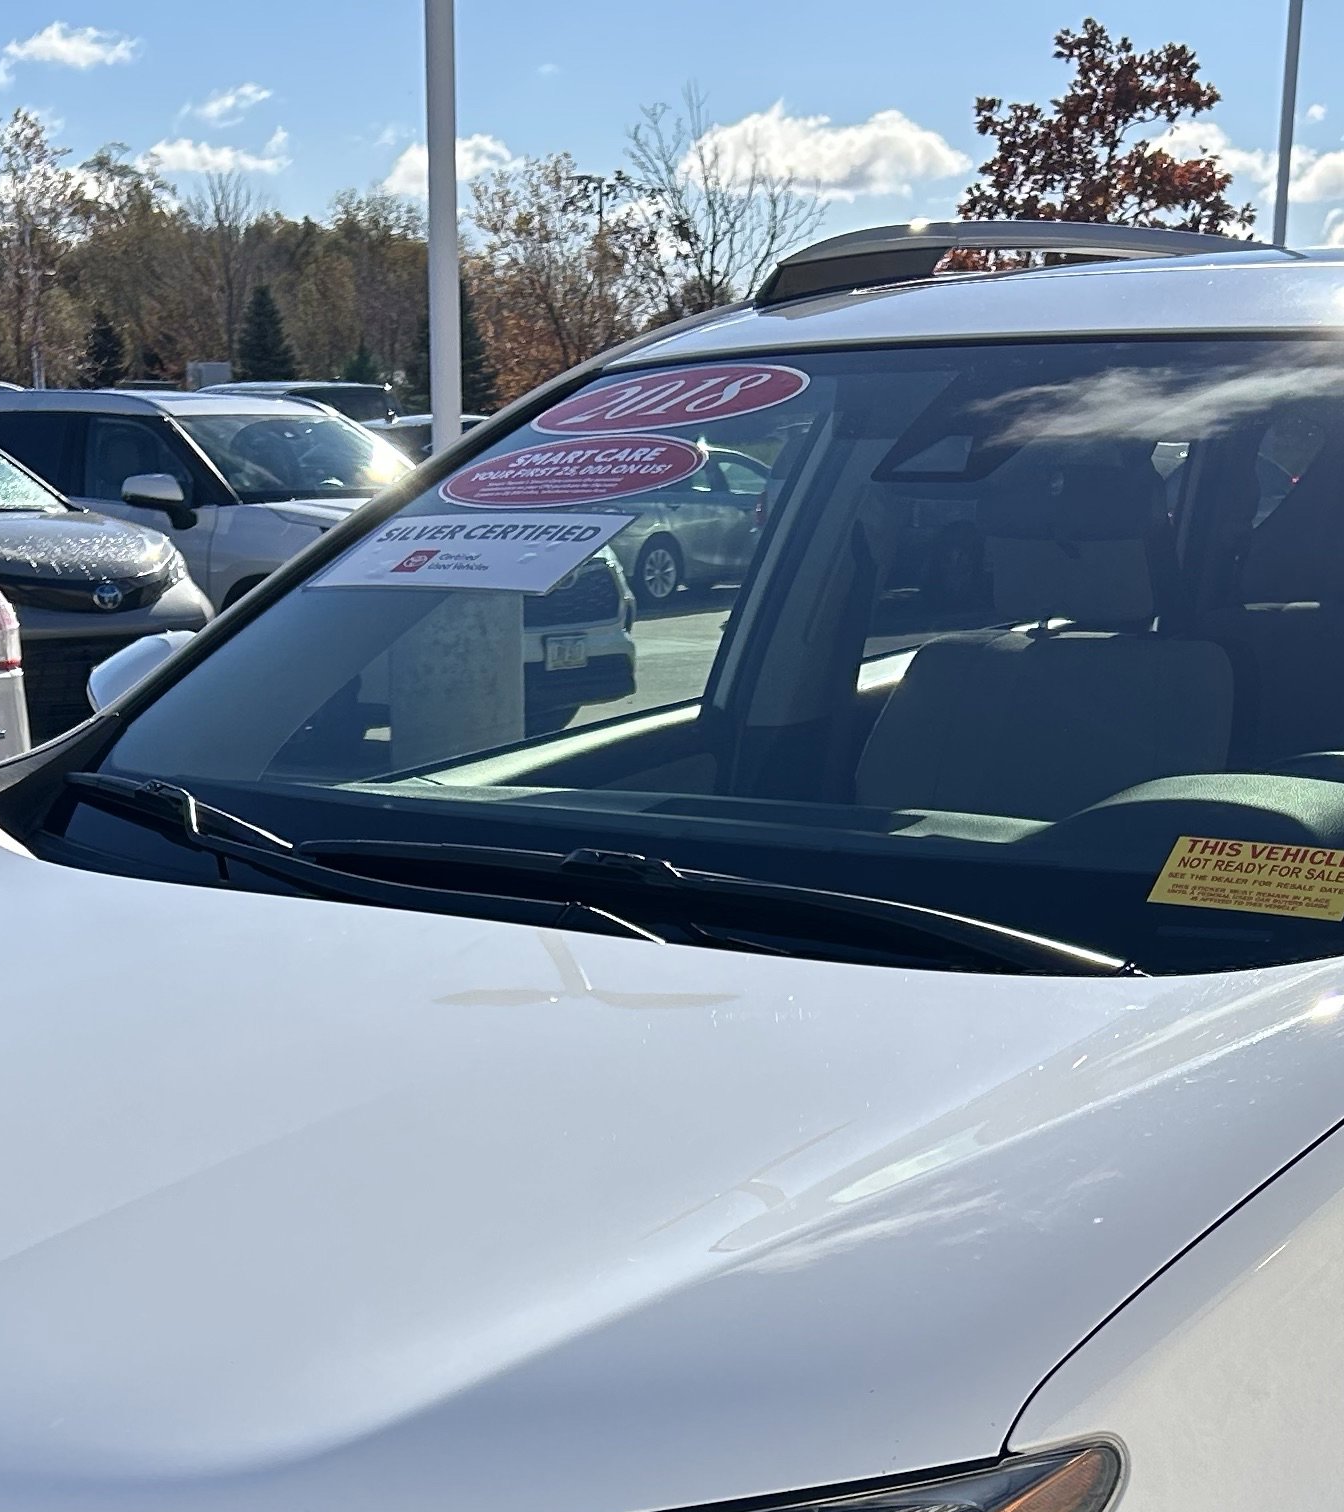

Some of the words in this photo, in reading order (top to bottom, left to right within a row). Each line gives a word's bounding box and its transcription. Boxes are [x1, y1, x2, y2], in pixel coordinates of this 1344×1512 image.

[556, 373, 772, 426] 2018
[508, 449, 600, 468] SMART
[594, 447, 668, 463] CARE
[470, 470, 516, 482] YOUR
[512, 466, 560, 479] FIRST
[611, 464, 642, 474] ON
[376, 524, 465, 542] SILVER
[462, 524, 602, 542] CERTIFIED
[1187, 839, 1244, 857] THIS
[1177, 856, 1212, 870] NOT
[1212, 859, 1268, 876] READY
[1268, 864, 1302, 880] FOR
[1168, 872, 1186, 880] SEE
[1190, 873, 1208, 881] THE
[1210, 875, 1249, 885] DEALER
[1252, 880, 1273, 888] FOR
[1276, 882, 1316, 892] RESALE
